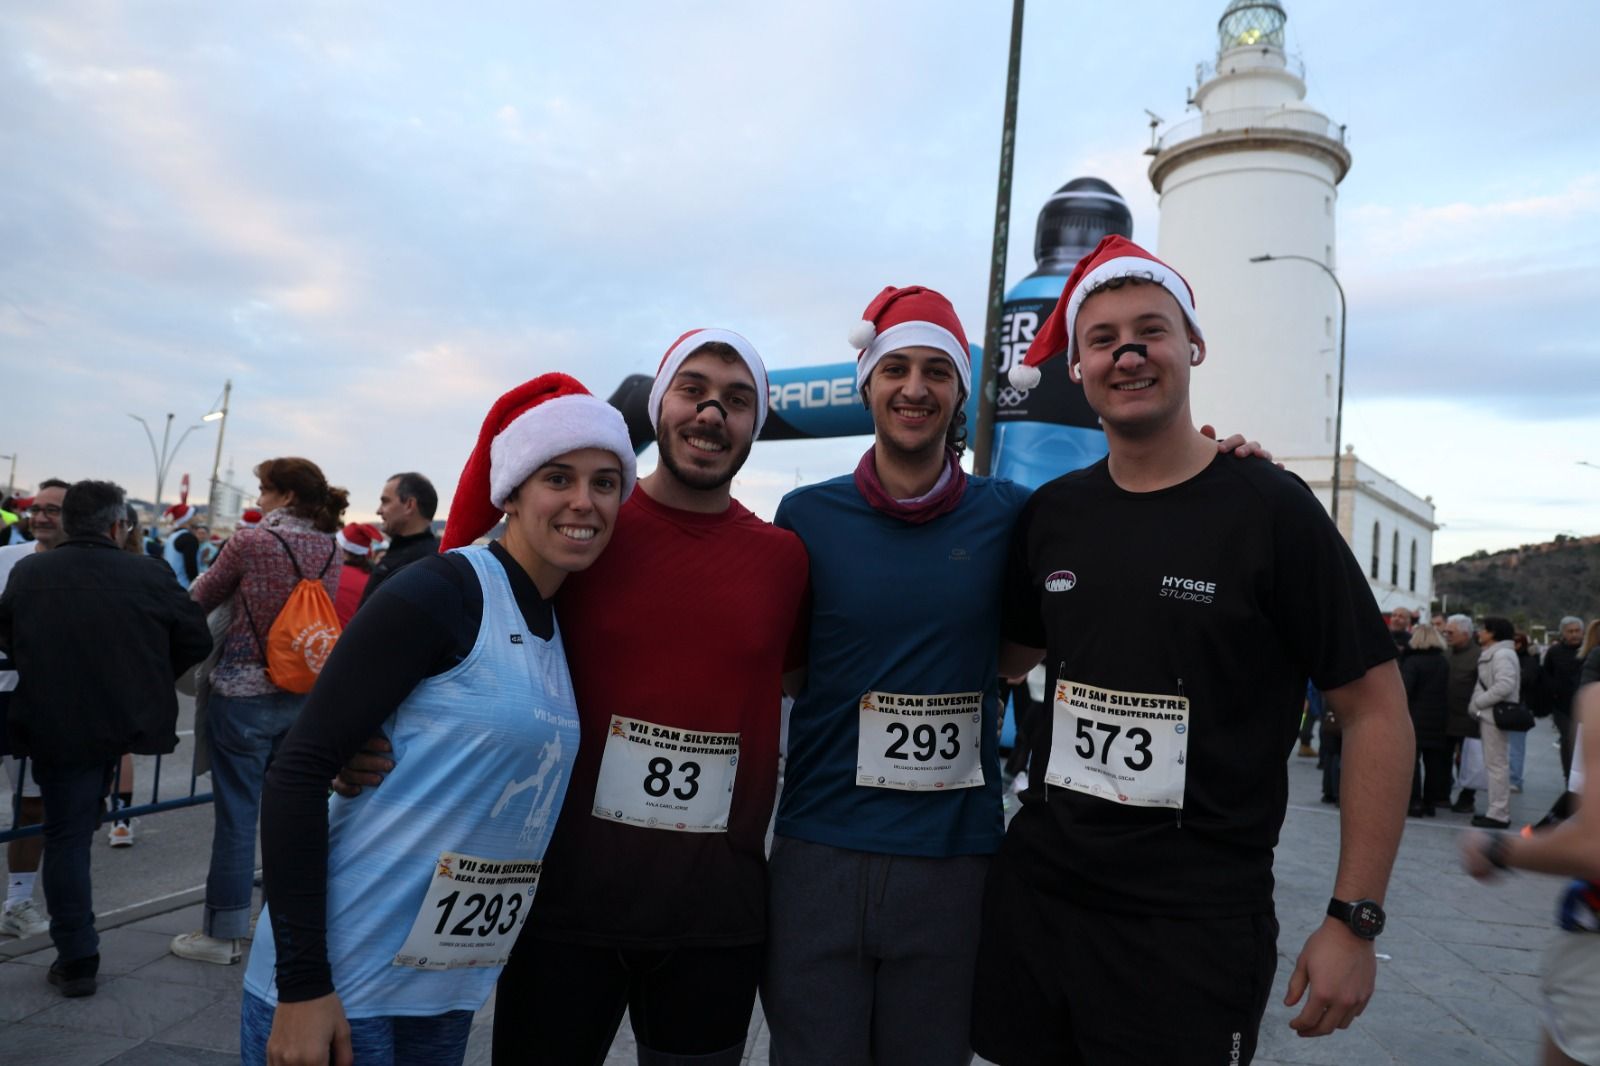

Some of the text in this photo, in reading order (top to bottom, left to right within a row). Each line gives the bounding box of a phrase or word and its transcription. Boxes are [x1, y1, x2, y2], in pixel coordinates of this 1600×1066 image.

[1162, 576, 1216, 594] HYGGE
[1160, 588, 1214, 604] STUDIOS
[878, 696, 980, 707] VII SAN SILVESTRE
[1070, 699, 1088, 710] REAL
[1090, 704, 1106, 714] CLUB
[1072, 686, 1186, 710] VII SAN SILVESTRE
[878, 707, 900, 715] REAL
[630, 722, 648, 734] VII
[652, 728, 680, 741] SAN
[628, 735, 652, 746] REAL
[654, 741, 678, 750] CLUB
[884, 722, 960, 762] 293
[1075, 717, 1153, 772] 573
[643, 756, 701, 800] 83
[458, 859, 477, 872] VII
[478, 864, 501, 874] SAN
[454, 874, 476, 884] REAL
[477, 876, 496, 884] CLUB
[434, 890, 523, 937] 1293
[1230, 1032, 1241, 1066] idas
